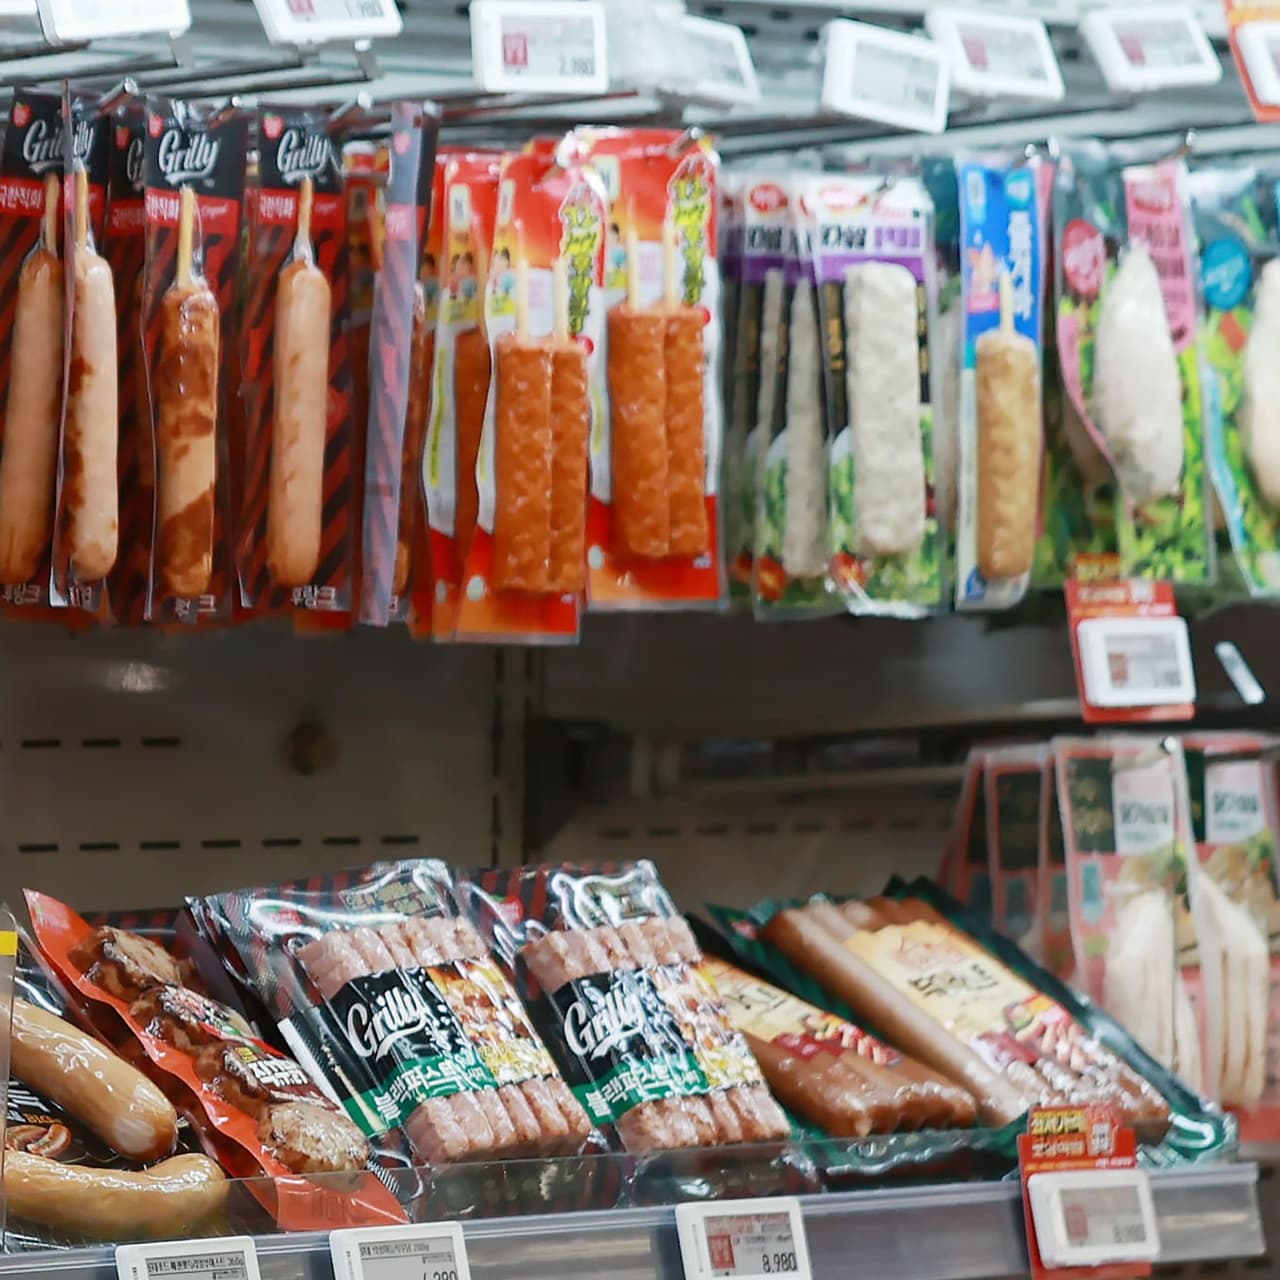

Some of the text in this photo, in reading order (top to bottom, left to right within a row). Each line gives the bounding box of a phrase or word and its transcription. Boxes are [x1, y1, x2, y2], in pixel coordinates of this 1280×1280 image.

[158, 126, 220, 185] Grilly
[276, 129, 328, 183] Grilly
[347, 986, 428, 1063] Grilly
